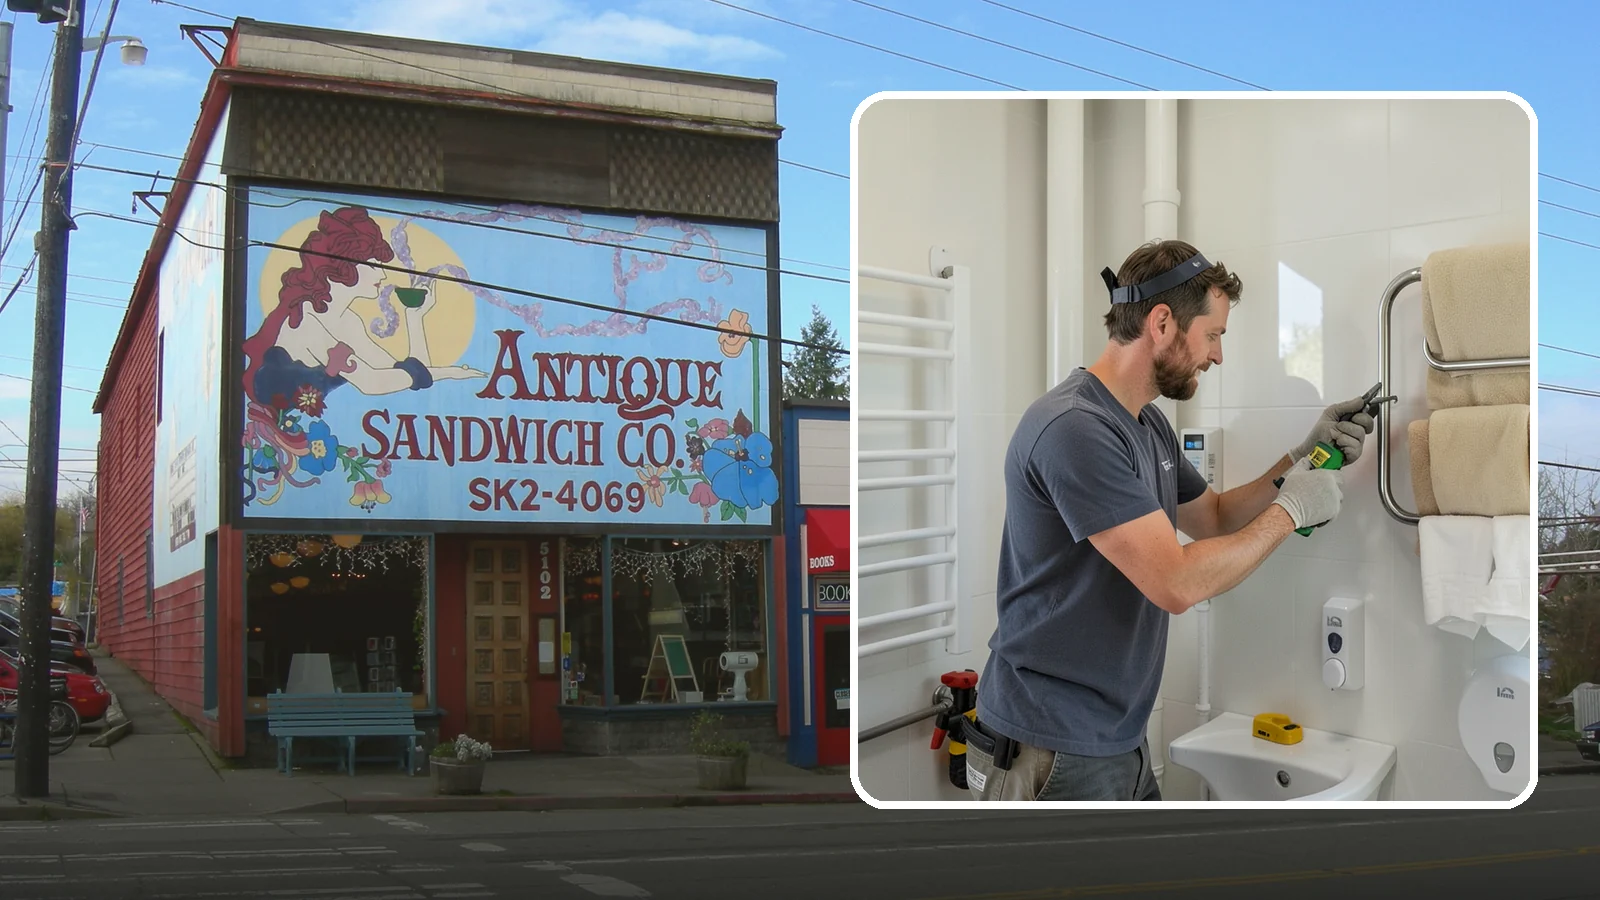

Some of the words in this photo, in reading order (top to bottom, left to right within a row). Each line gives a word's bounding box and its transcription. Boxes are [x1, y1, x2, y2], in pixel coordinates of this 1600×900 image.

[475, 329, 723, 420] ANTIQUE
[361, 408, 604, 467] SANDWICH
[617, 422, 685, 468] CO.
[468, 477, 645, 513] SK2-4069
[540, 541, 552, 599] 5102
[809, 554, 834, 569] BOOKS
